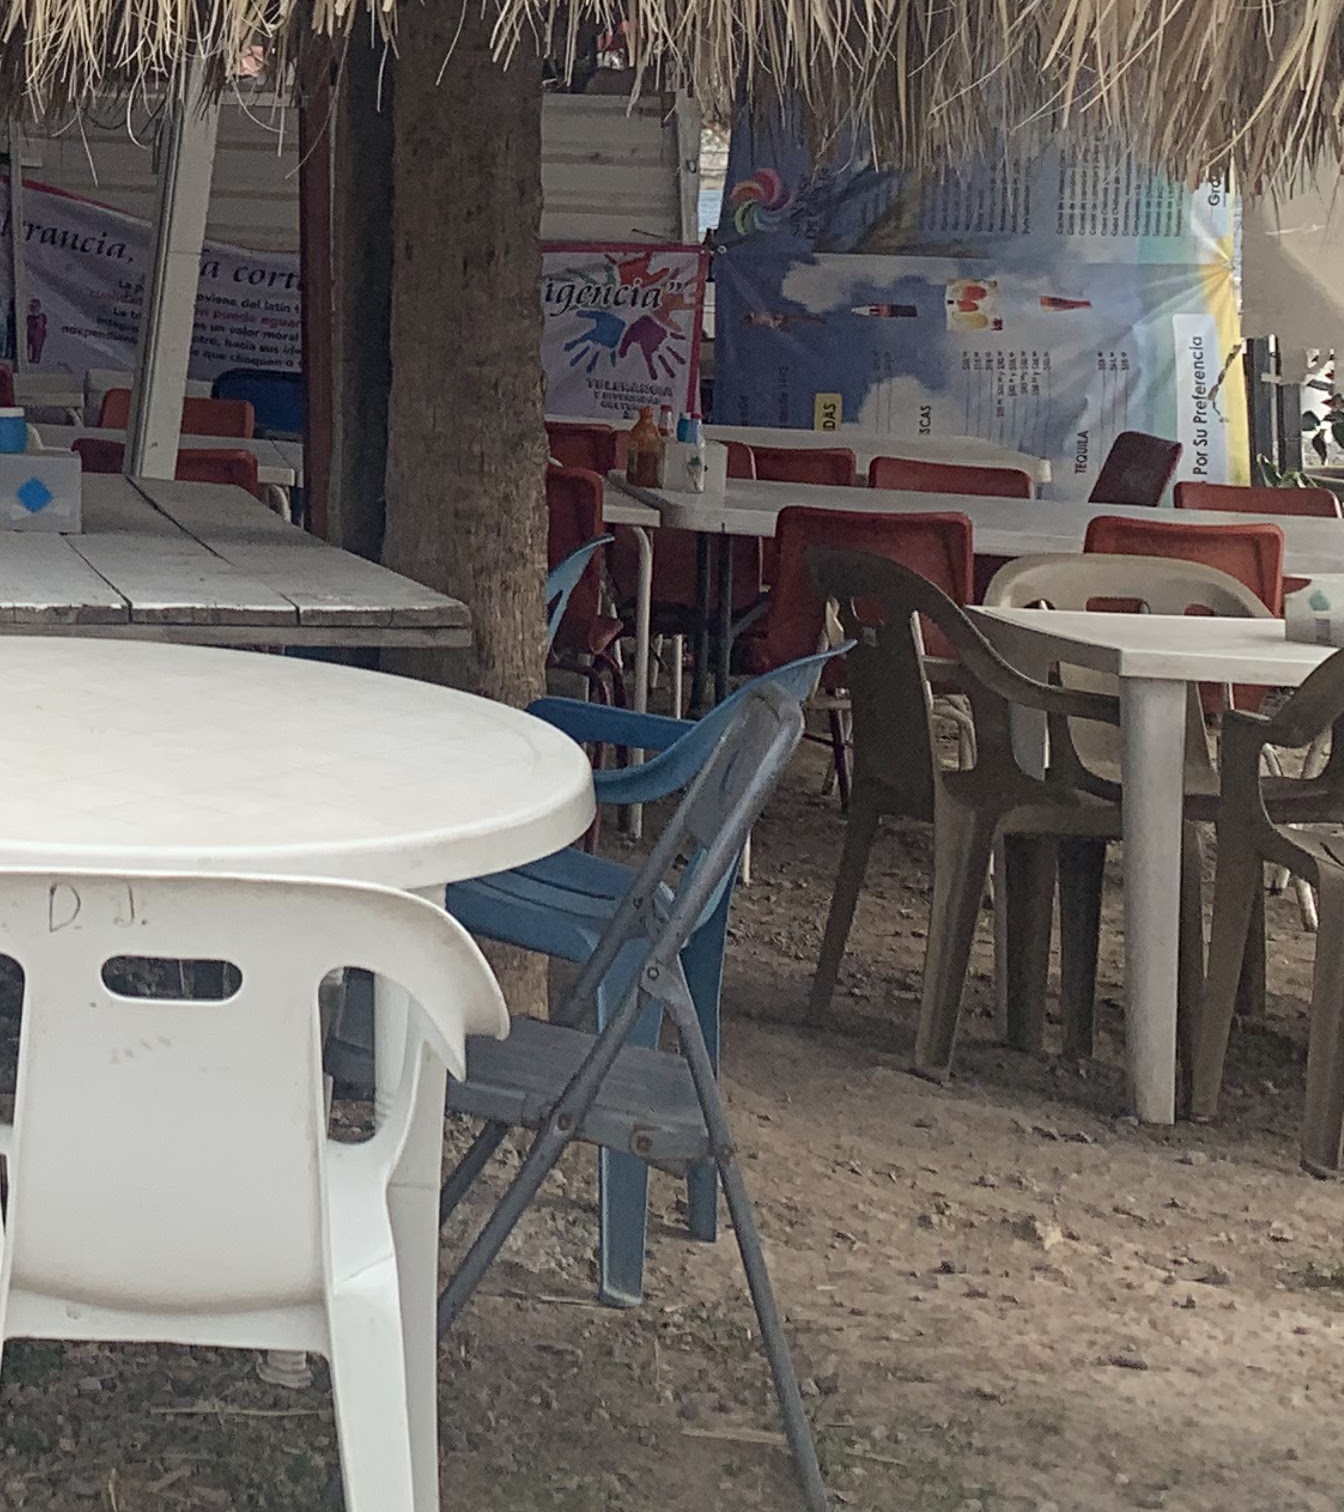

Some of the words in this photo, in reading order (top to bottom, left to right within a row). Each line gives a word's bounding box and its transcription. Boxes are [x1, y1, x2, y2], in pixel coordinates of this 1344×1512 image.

[233, 266, 302, 291] cort
[1188, 336, 1208, 424] Preferencia
[1192, 429, 1208, 447] Su
[1074, 430, 1088, 474] TEQUILA
[1192, 450, 1209, 476] Por
